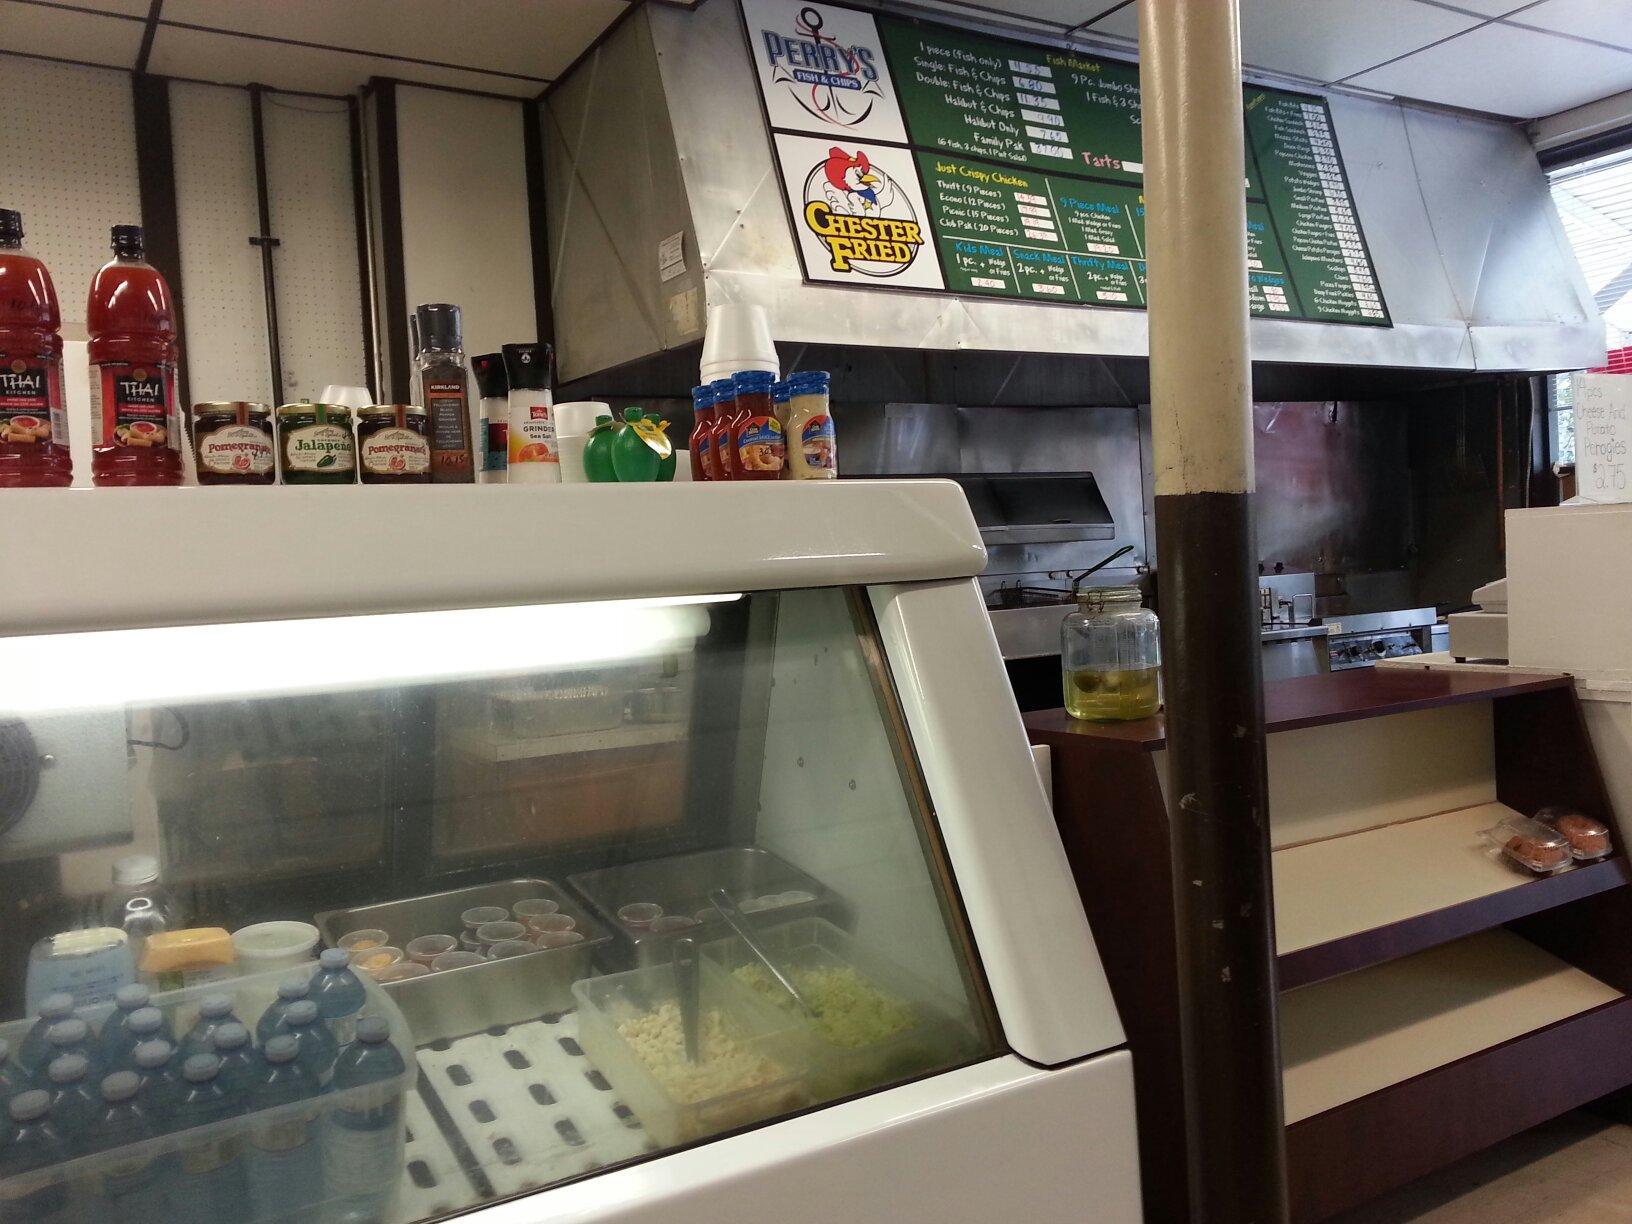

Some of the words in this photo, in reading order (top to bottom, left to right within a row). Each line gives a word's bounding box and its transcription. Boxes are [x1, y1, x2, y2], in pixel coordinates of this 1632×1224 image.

[761, 29, 879, 82] PERRY'S
[919, 41, 924, 51] 1
[926, 45, 951, 57] piece
[1046, 54, 1068, 66] Fish
[796, 72, 820, 83] FISH
[820, 75, 829, 85] &
[829, 75, 861, 89] CHIPS
[948, 63, 969, 77] Fish
[979, 70, 1006, 86] Chips
[953, 79, 975, 95] Fish
[983, 87, 1010, 103] Chips
[1092, 92, 1111, 105] Fish
[944, 93, 978, 110] Halibut
[988, 104, 1015, 119] Chips
[963, 114, 997, 130] Halibut
[998, 121, 1020, 138] Only
[973, 132, 1004, 150] Family
[1005, 139, 1025, 151] Pak
[1081, 151, 1121, 170] Tarts
[935, 161, 957, 175] Just
[958, 165, 990, 183] Crispy
[991, 172, 1029, 188] Chicken
[936, 180, 961, 191] Thrift
[939, 192, 963, 204] Econo
[942, 205, 966, 217] Picnic
[804, 200, 924, 245] CHESTER
[939, 217, 957, 228] Club
[825, 236, 912, 272] FRIED
[955, 241, 978, 255] Kids
[979, 244, 1004, 257] Meal
[1013, 248, 1041, 261] Snack
[1042, 252, 1065, 265] Meal
[1070, 256, 1105, 270] Thrifty
[1106, 259, 1129, 271] Meal
[120, 380, 160, 398] THAI
[1576, 402, 1606, 421] Cheese
[1609, 403, 1626, 420] And
[1592, 463, 1627, 490] $2.75
